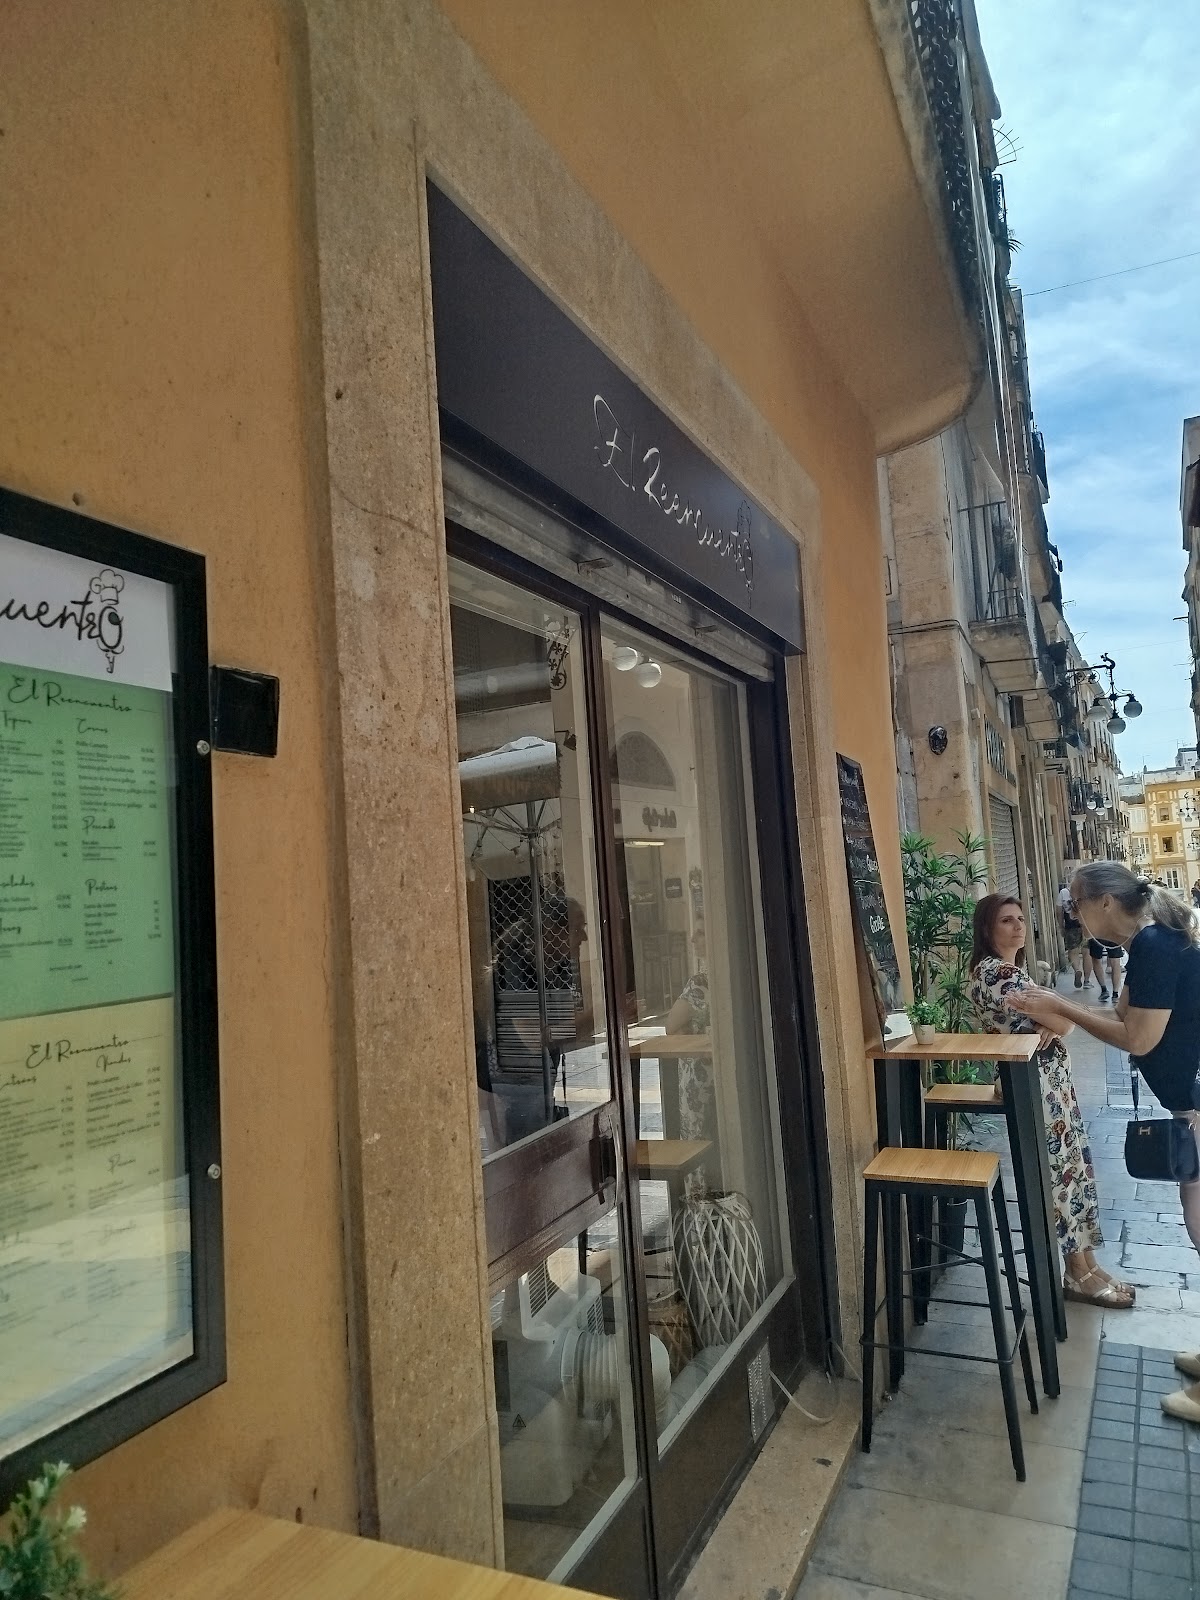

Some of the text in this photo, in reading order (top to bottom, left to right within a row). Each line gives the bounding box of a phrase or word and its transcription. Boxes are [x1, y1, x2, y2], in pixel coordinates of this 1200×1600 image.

[593, 394, 636, 492] El
[0, 590, 123, 649] uentro
[7, 674, 133, 712] El Reencuentro
[26, 1033, 130, 1069] El Reencuentro
